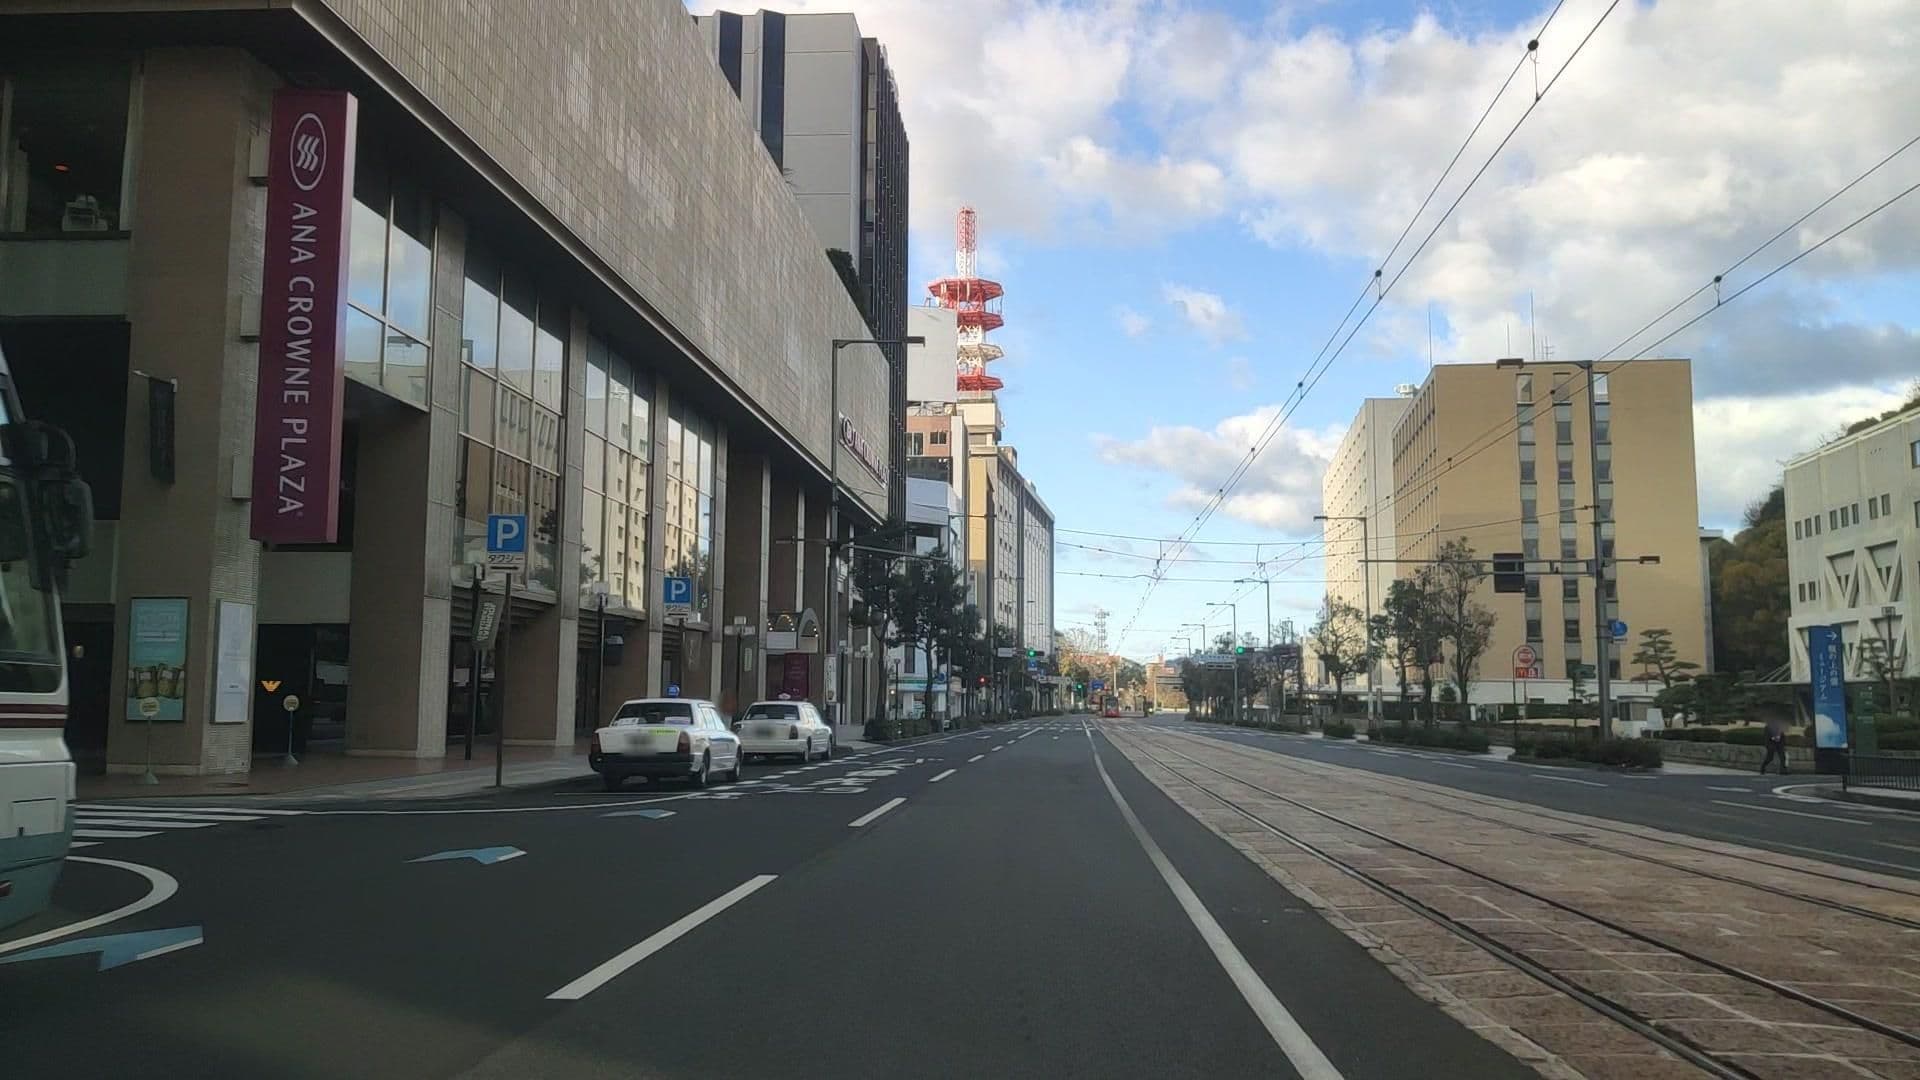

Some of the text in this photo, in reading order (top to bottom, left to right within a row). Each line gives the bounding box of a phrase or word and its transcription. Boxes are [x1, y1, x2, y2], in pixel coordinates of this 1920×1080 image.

[278, 202, 318, 514] ANA CROWNE PLAZA
[496, 518, 520, 549] P
[487, 554, 524, 563] タクシー
[671, 580, 687, 601] P
